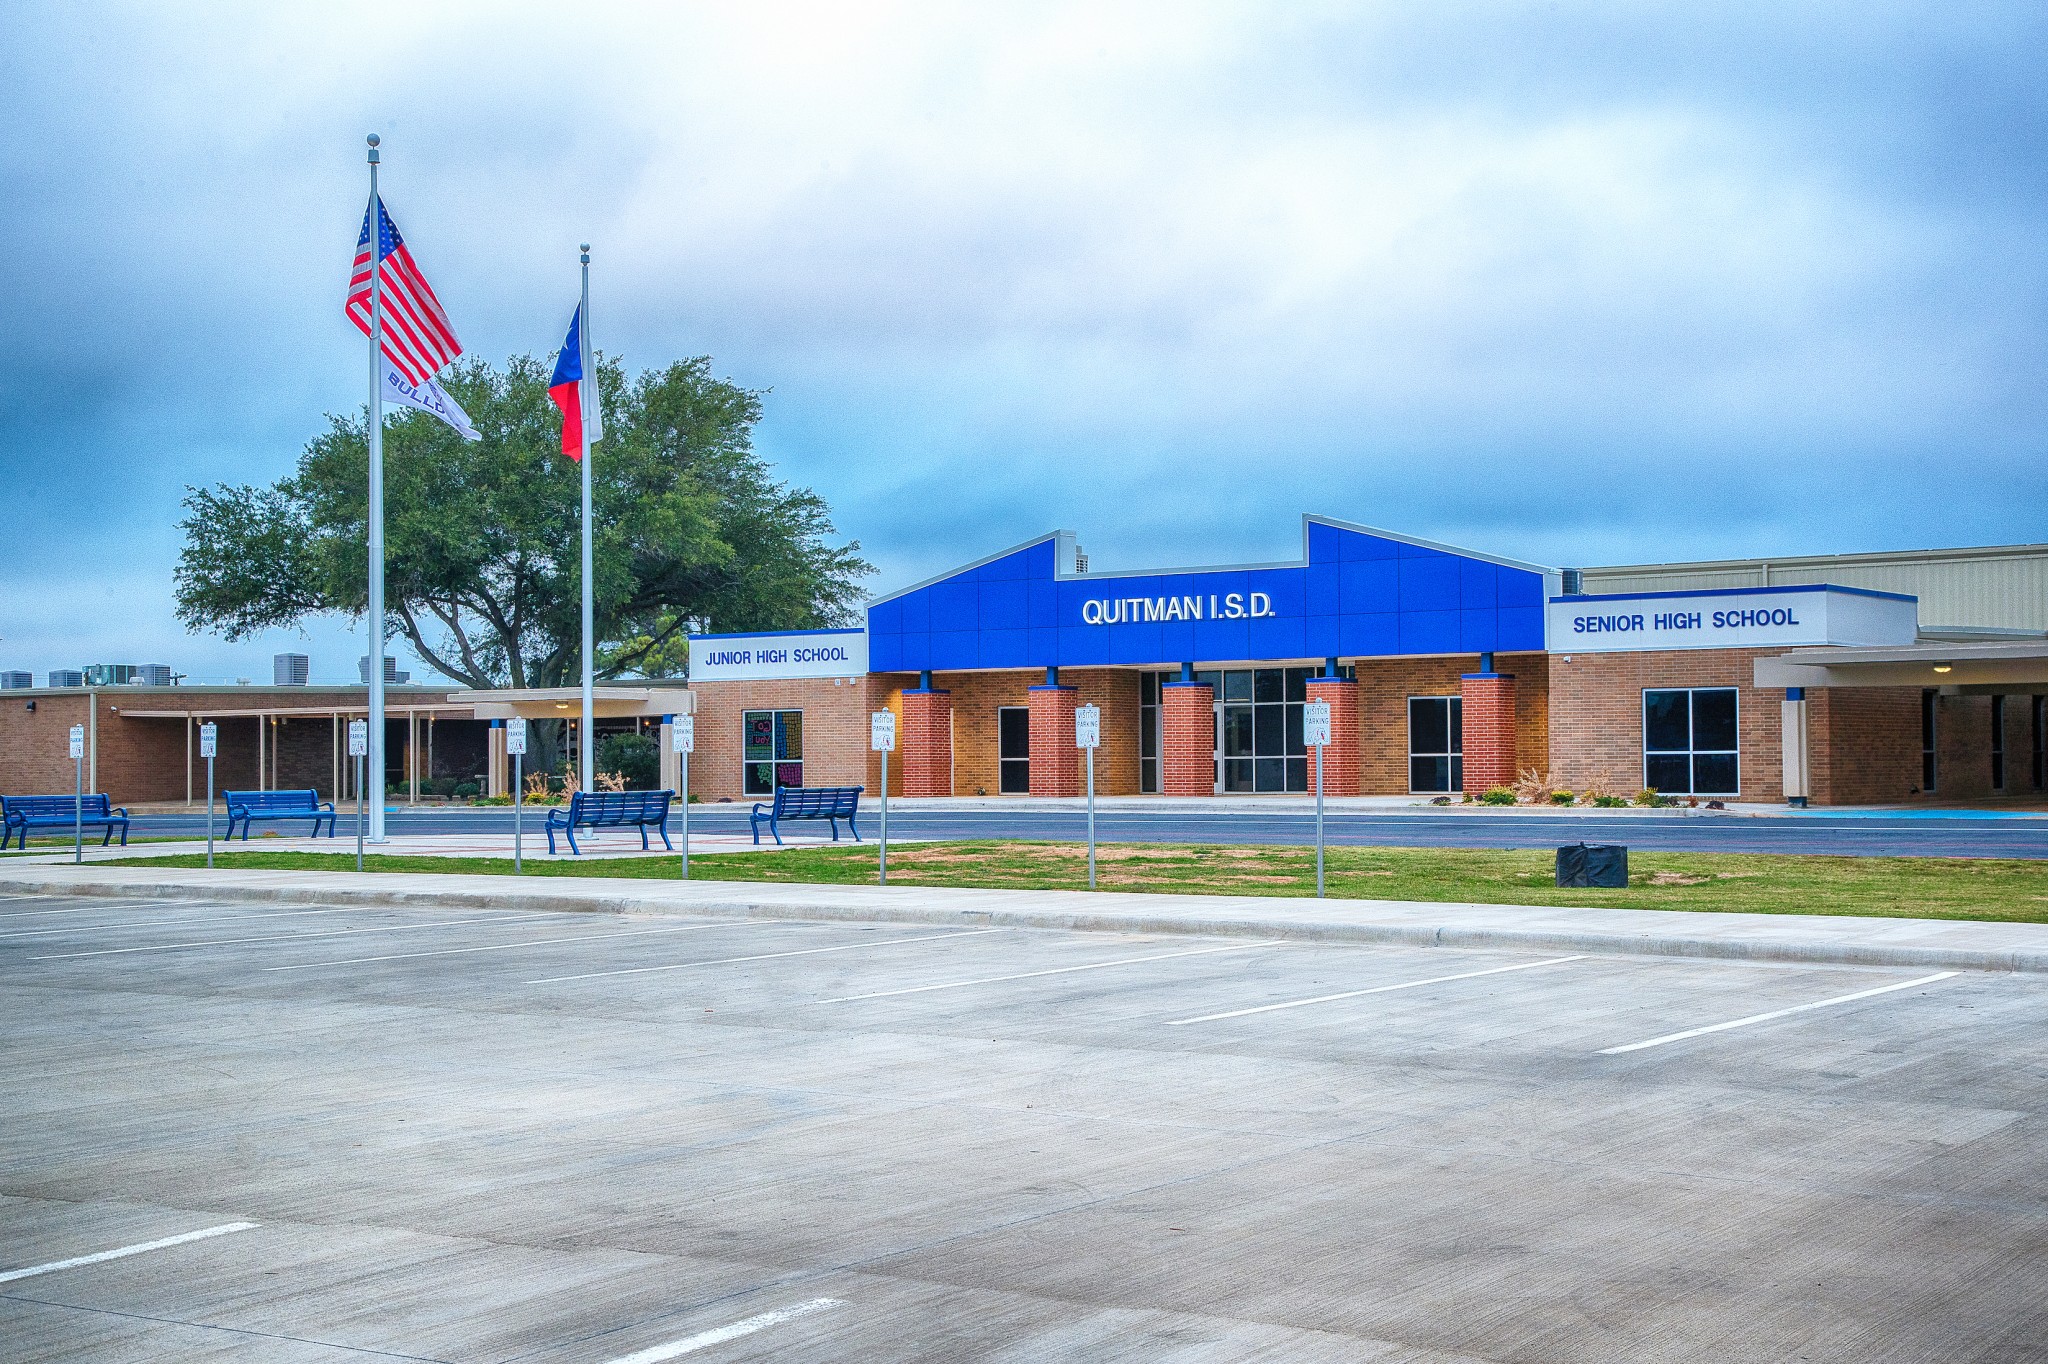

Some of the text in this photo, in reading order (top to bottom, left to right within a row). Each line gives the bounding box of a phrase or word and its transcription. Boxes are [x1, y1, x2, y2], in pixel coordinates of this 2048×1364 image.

[1082, 592, 1276, 625] QUITMAN I.S.D.
[1573, 608, 1800, 633] SENIOR HIGH SCHOOL
[705, 647, 849, 666] JUNIOR HIGH SCHOOL
